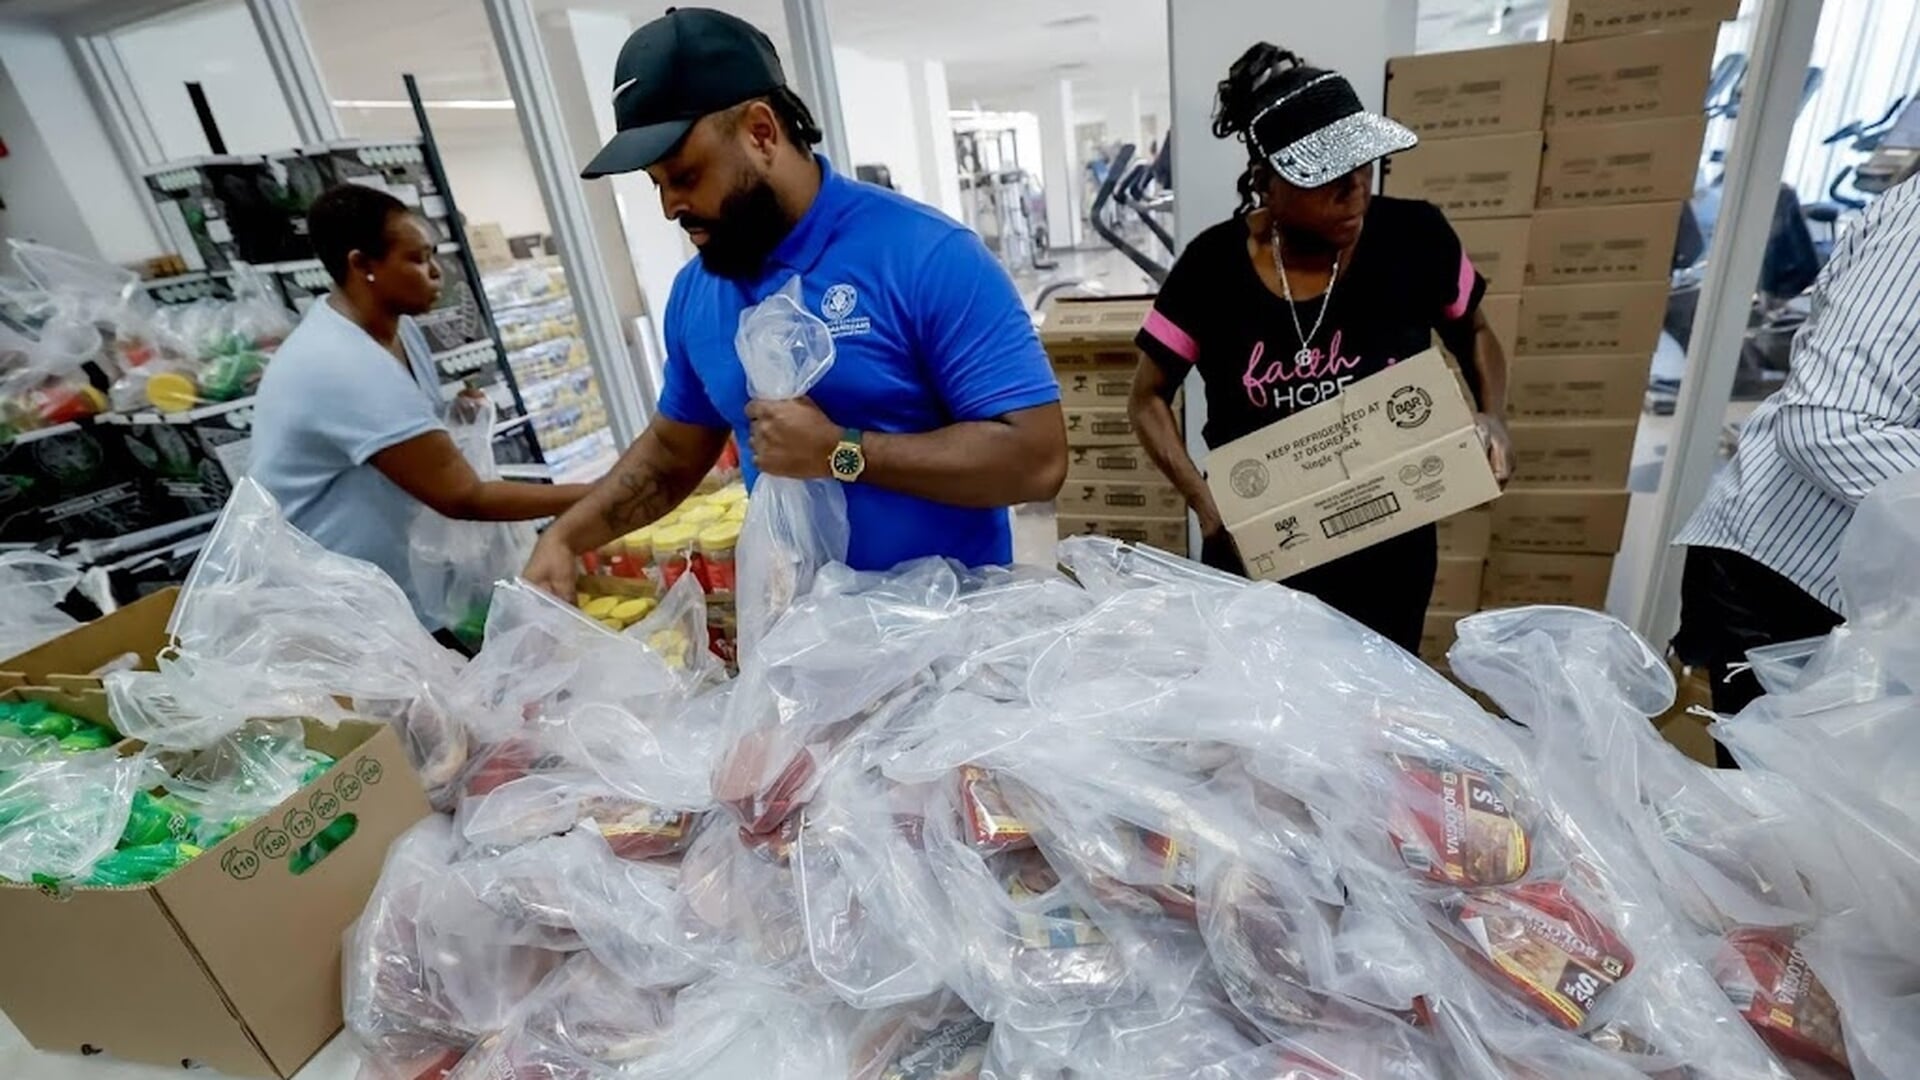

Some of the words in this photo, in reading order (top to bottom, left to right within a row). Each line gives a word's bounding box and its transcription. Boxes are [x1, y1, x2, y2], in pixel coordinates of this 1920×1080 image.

[1265, 443, 1291, 461] KEEP
[1368, 401, 1381, 414] AT
[1442, 786, 1460, 855] BOLOGNA
[1473, 786, 1494, 805] S
[233, 856, 254, 875] 110
[266, 835, 286, 854] 150
[294, 817, 311, 834] 175
[319, 798, 336, 816] 200
[343, 780, 359, 798] 230
[1577, 972, 1600, 998] S
[1777, 947, 1804, 1005] OLOGNA
